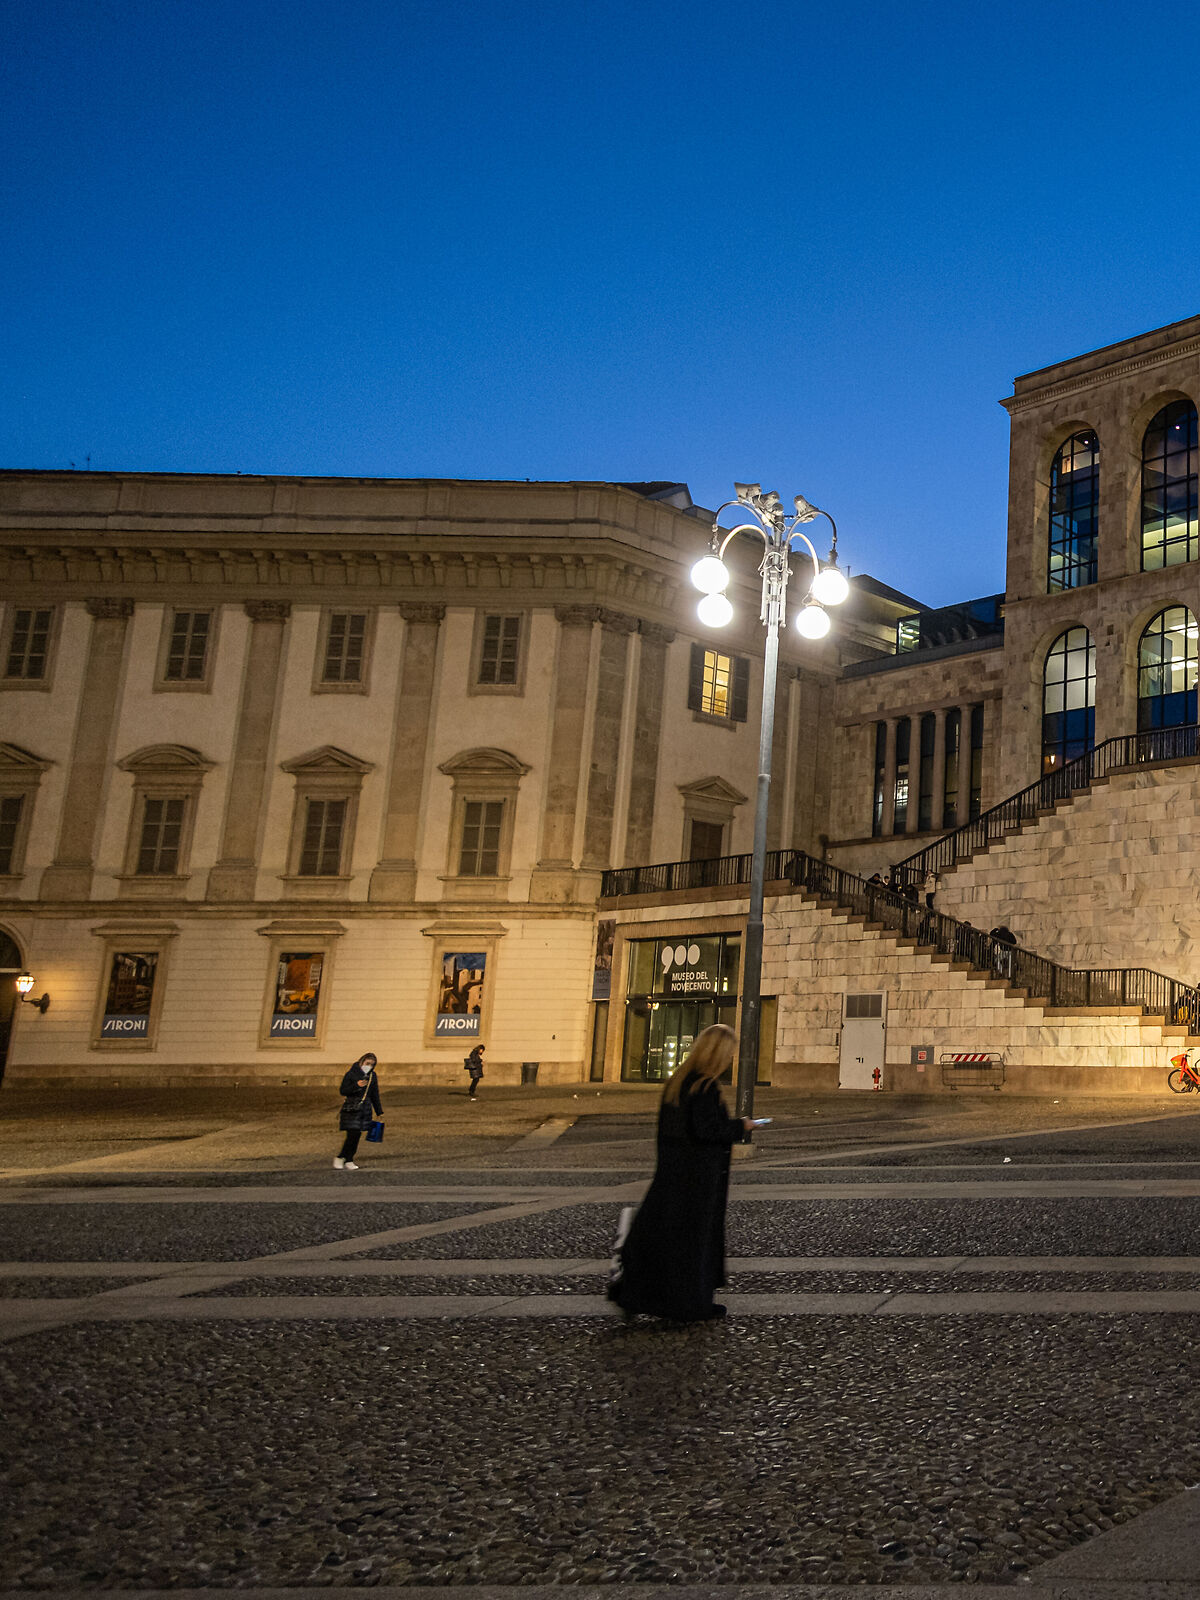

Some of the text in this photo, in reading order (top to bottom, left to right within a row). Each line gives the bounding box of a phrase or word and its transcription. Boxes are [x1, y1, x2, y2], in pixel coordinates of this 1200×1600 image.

[661, 944, 701, 974] 900
[672, 971, 709, 982] MUSEO DEL
[671, 981, 712, 992] NOVECENTO
[104, 1019, 146, 1030] SIRONI
[272, 1019, 314, 1030] SIRONI
[437, 1018, 478, 1030] SIRONI
